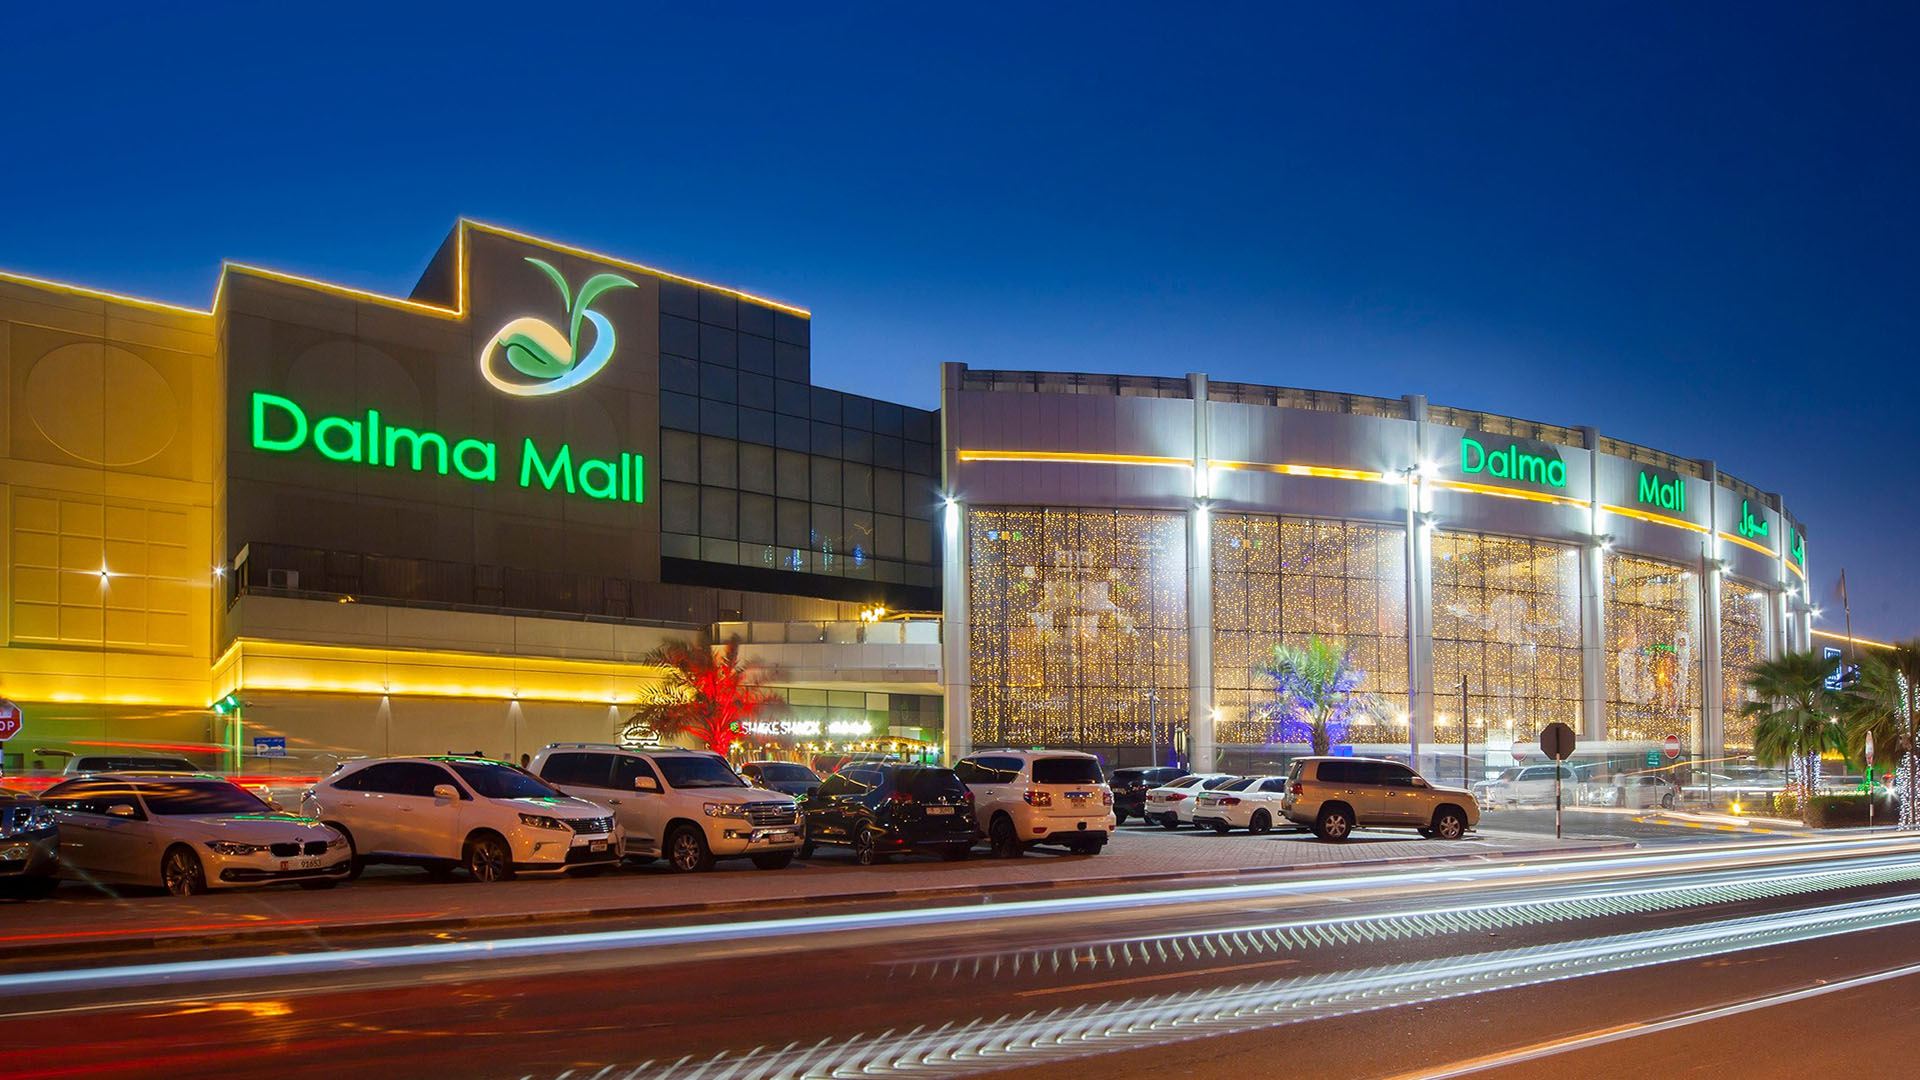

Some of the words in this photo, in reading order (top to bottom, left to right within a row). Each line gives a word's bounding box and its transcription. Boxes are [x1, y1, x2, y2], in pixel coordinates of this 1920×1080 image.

[252, 392, 497, 481] Dalma
[520, 438, 644, 503] Mall
[1461, 438, 1567, 488] Dalma
[1637, 472, 1686, 513] Mall
[1738, 500, 1768, 539] مول
[741, 721, 779, 735] SHAKE
